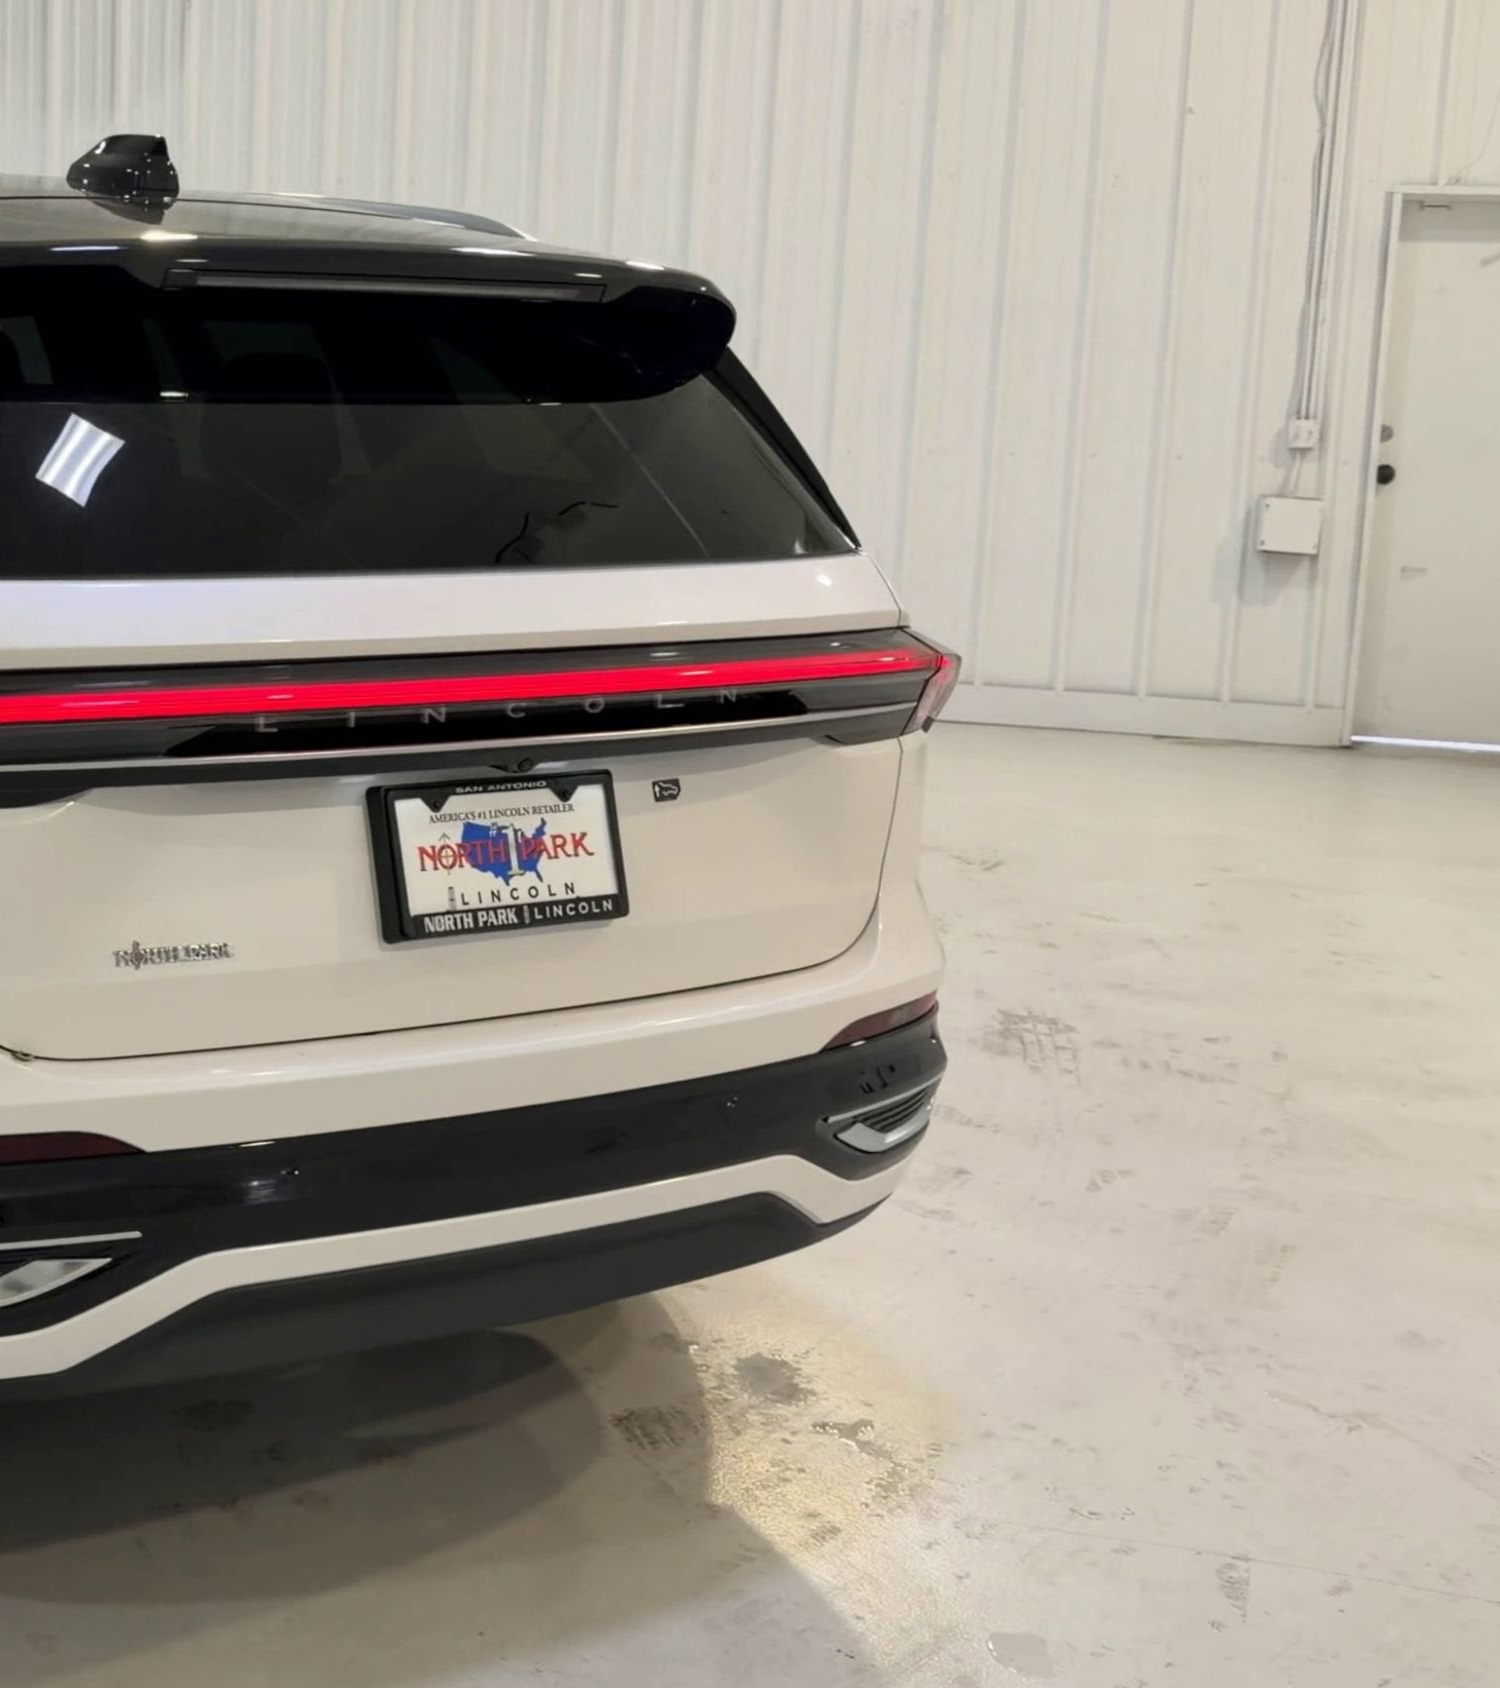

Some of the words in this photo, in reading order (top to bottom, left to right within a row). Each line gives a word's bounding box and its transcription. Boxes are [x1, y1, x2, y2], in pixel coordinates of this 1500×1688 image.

[255, 688, 738, 733] LINCOLN
[455, 786, 483, 794] SAN
[487, 780, 547, 792] ANTONIO
[429, 810, 477, 824] AMERICA'S
[488, 804, 530, 820] LINCOLN
[531, 802, 575, 816] RETAILER
[417, 838, 507, 872] NORTH
[520, 831, 596, 861] PARK
[460, 882, 576, 906] LINCOLN
[423, 911, 475, 934] NORTH
[476, 907, 519, 927] PARK
[534, 898, 614, 920] LINCOLN
